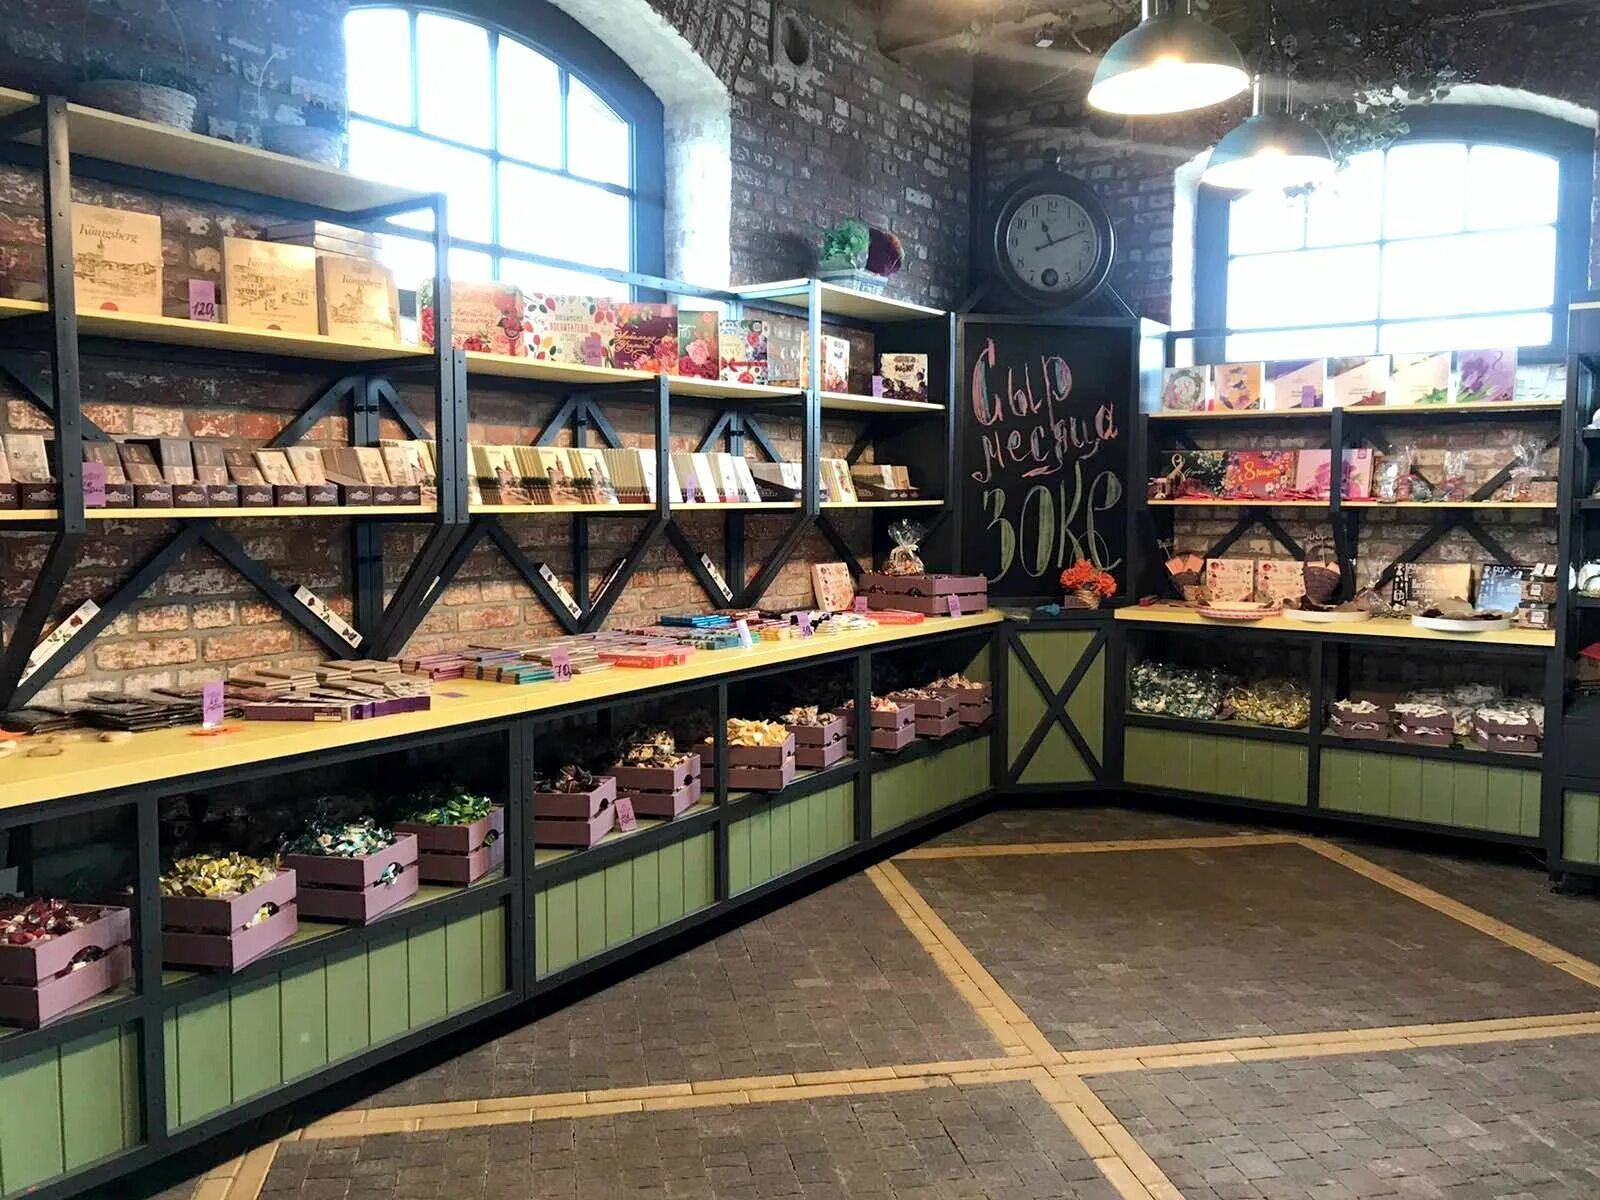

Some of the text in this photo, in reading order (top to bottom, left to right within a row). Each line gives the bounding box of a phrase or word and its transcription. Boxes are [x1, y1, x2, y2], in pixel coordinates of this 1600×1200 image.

[1031, 204, 1039, 217] 11
[1047, 199, 1058, 213] 12
[1017, 218, 1027, 230] 10
[80, 223, 139, 243] Königsberg
[1016, 256, 1025, 269] 8
[1030, 269, 1035, 281] 7
[1063, 271, 1071, 282] 5
[972, 337, 1073, 431] Сыр
[971, 400, 1119, 484] месяца
[1244, 461, 1256, 481] 8
